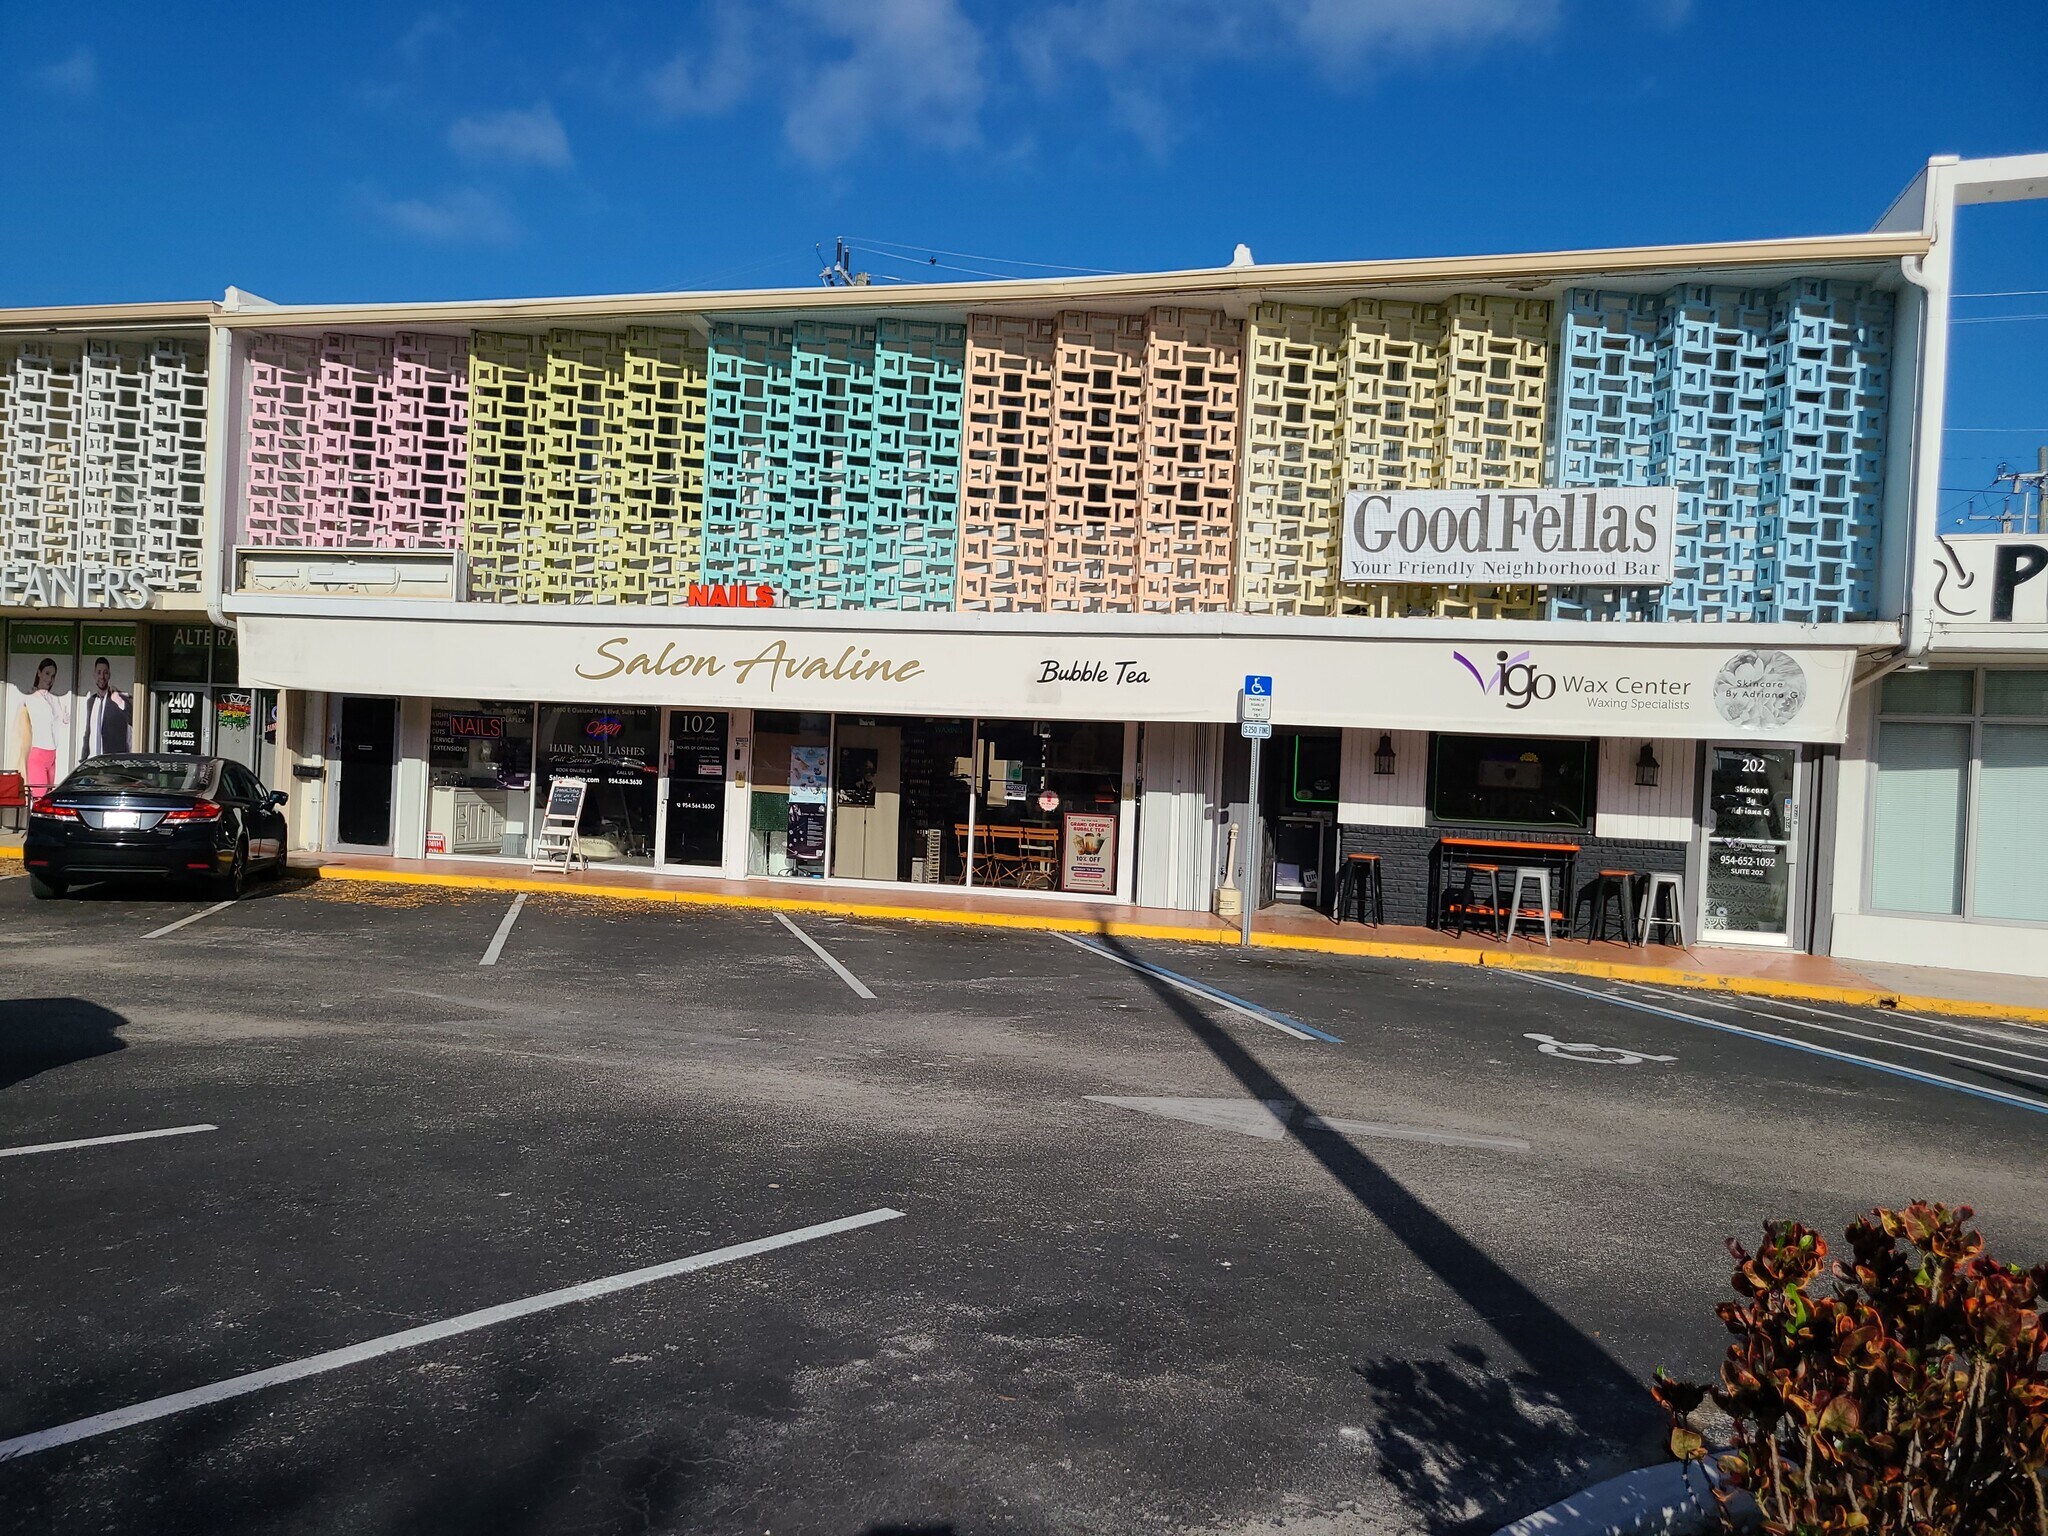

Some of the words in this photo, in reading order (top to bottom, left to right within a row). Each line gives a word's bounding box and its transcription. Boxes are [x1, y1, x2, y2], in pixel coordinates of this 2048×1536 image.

[1353, 492, 1658, 554] GoodFellas
[1351, 560, 1392, 575] Your
[1398, 561, 1475, 578] Friendly
[1482, 561, 1616, 580] Neighborhood
[1624, 563, 1661, 576] Bar
[688, 583, 776, 608] NAILS
[17, 634, 69, 646] INNOVA'S
[574, 637, 726, 681] Salon
[733, 639, 926, 693] Avaline
[1036, 660, 1109, 684] Bubble
[1115, 660, 1151, 686] Tea
[1562, 675, 1609, 694] Wax
[1615, 676, 1692, 696] Center
[1736, 679, 1784, 689] Skincare
[168, 691, 195, 708] 2400
[1725, 689, 1739, 700] By
[1741, 689, 1785, 700] Adriana
[1789, 690, 1799, 700] G
[1586, 697, 1629, 711] Waxing
[1630, 697, 1690, 711] Specialists
[621, 708, 635, 716] Suite
[451, 716, 501, 737] NAILS
[586, 720, 622, 737] Open
[682, 715, 716, 734] 102
[1244, 725, 1258, 734] $250
[1258, 726, 1269, 735] FINE
[162, 731, 195, 739] CLEANERS
[433, 745, 468, 753] EXTENSIONS
[549, 744, 574, 753] HAIR
[579, 745, 603, 754] NAIL
[608, 746, 646, 756] LASHES
[549, 754, 566, 763] Full
[567, 755, 592, 764] Service
[1741, 758, 1766, 773] 202
[682, 801, 716, 810] 954.564.3630
[1731, 806, 1762, 816] Adriana
[1763, 808, 1770, 816] G
[1719, 855, 1776, 867] 954-652-1092
[1730, 868, 1750, 876] SUITE
[1750, 868, 1764, 876] 202
